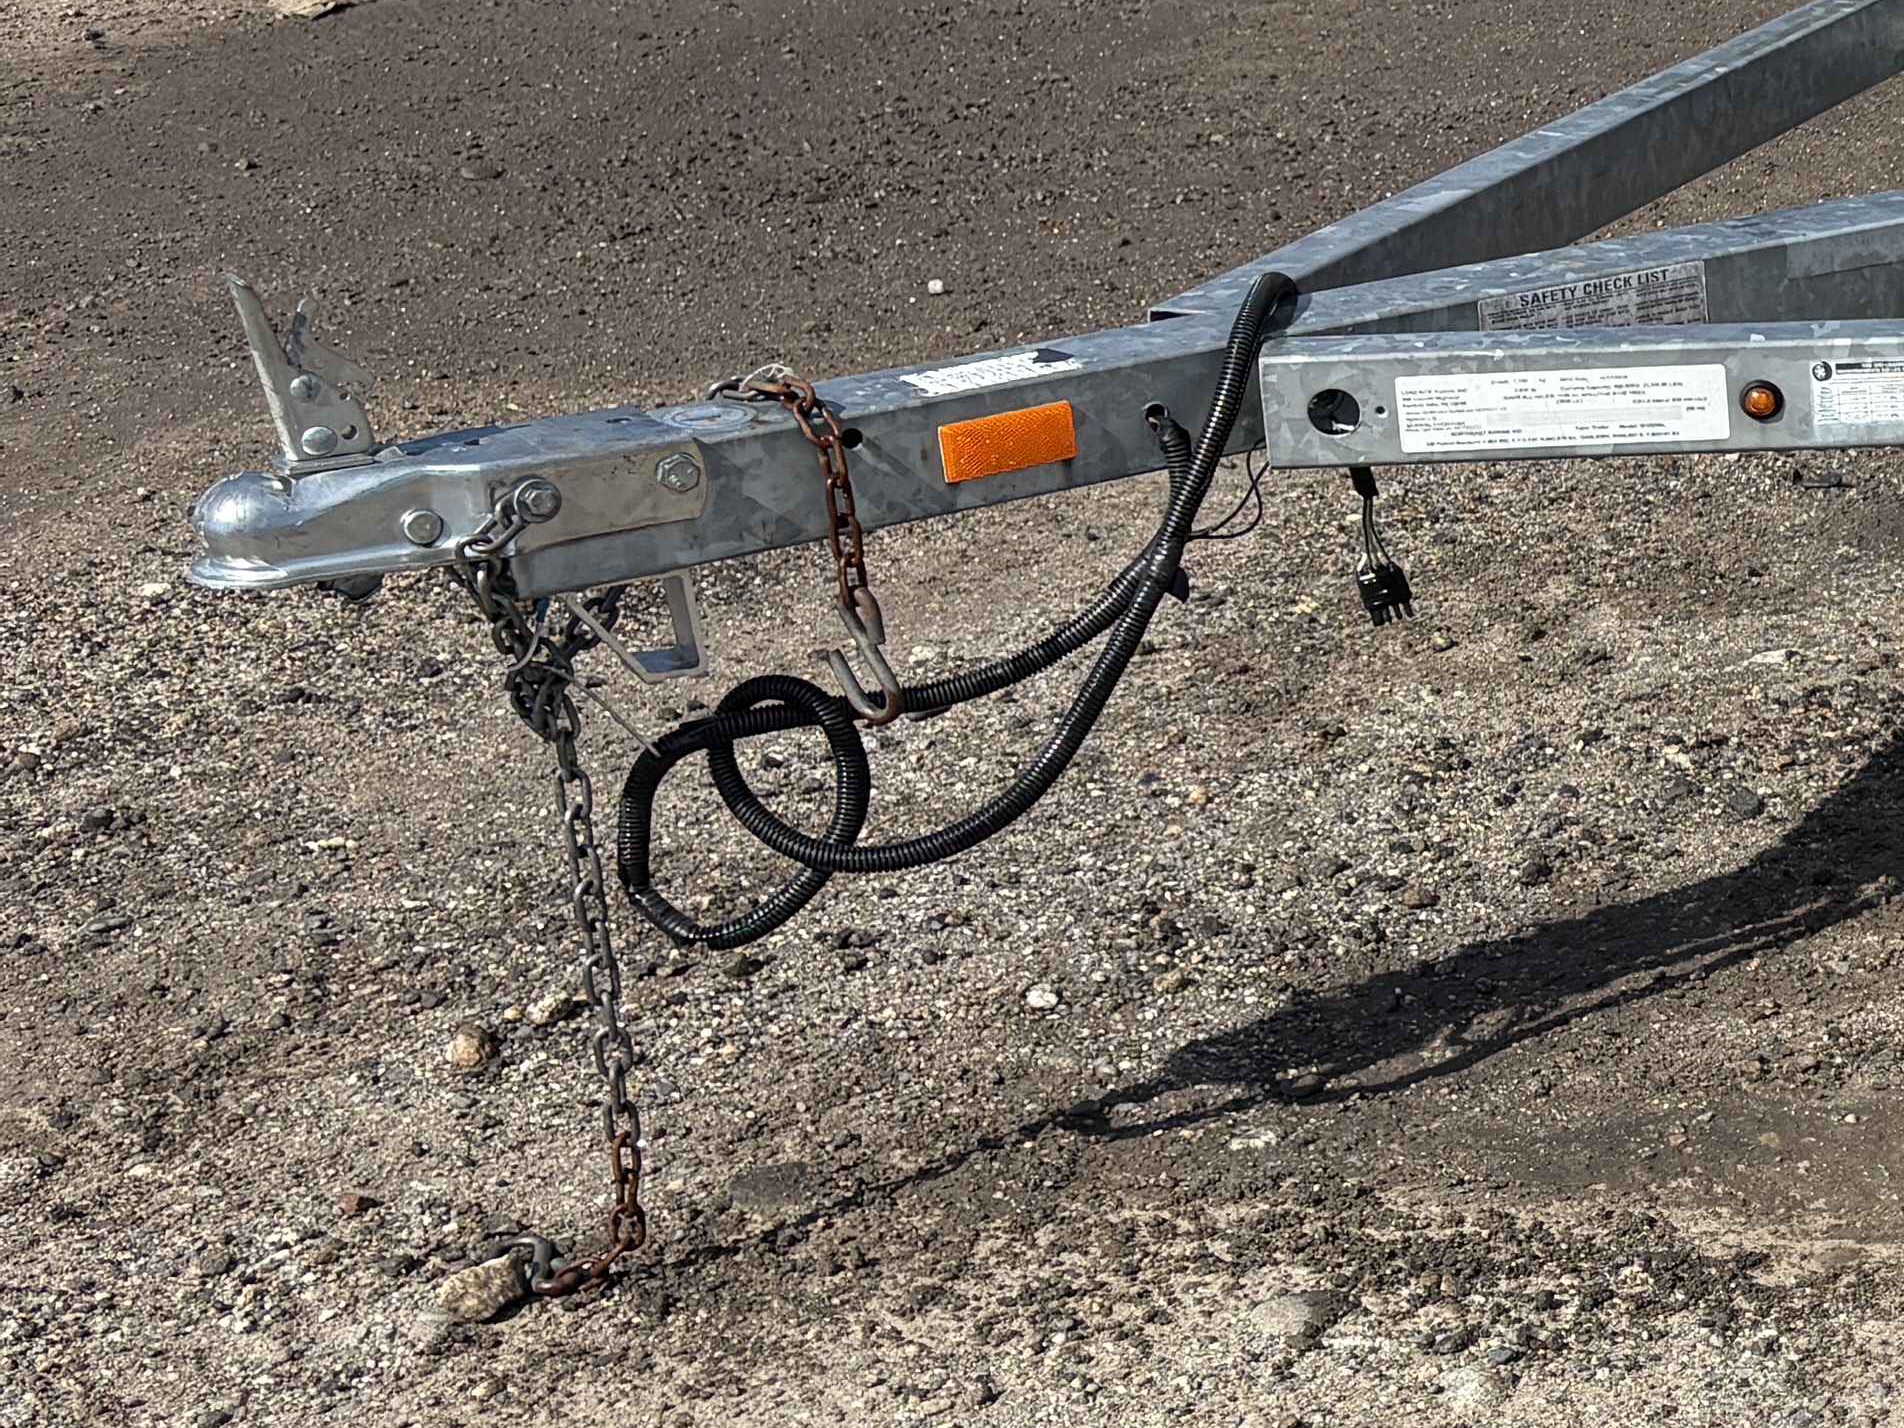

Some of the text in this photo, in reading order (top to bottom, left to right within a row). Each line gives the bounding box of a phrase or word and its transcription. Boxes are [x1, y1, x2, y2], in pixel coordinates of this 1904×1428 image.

[1520, 285, 1578, 308] SAFETY
[1583, 275, 1633, 296] CHECK
[1637, 269, 1669, 285] LIST
